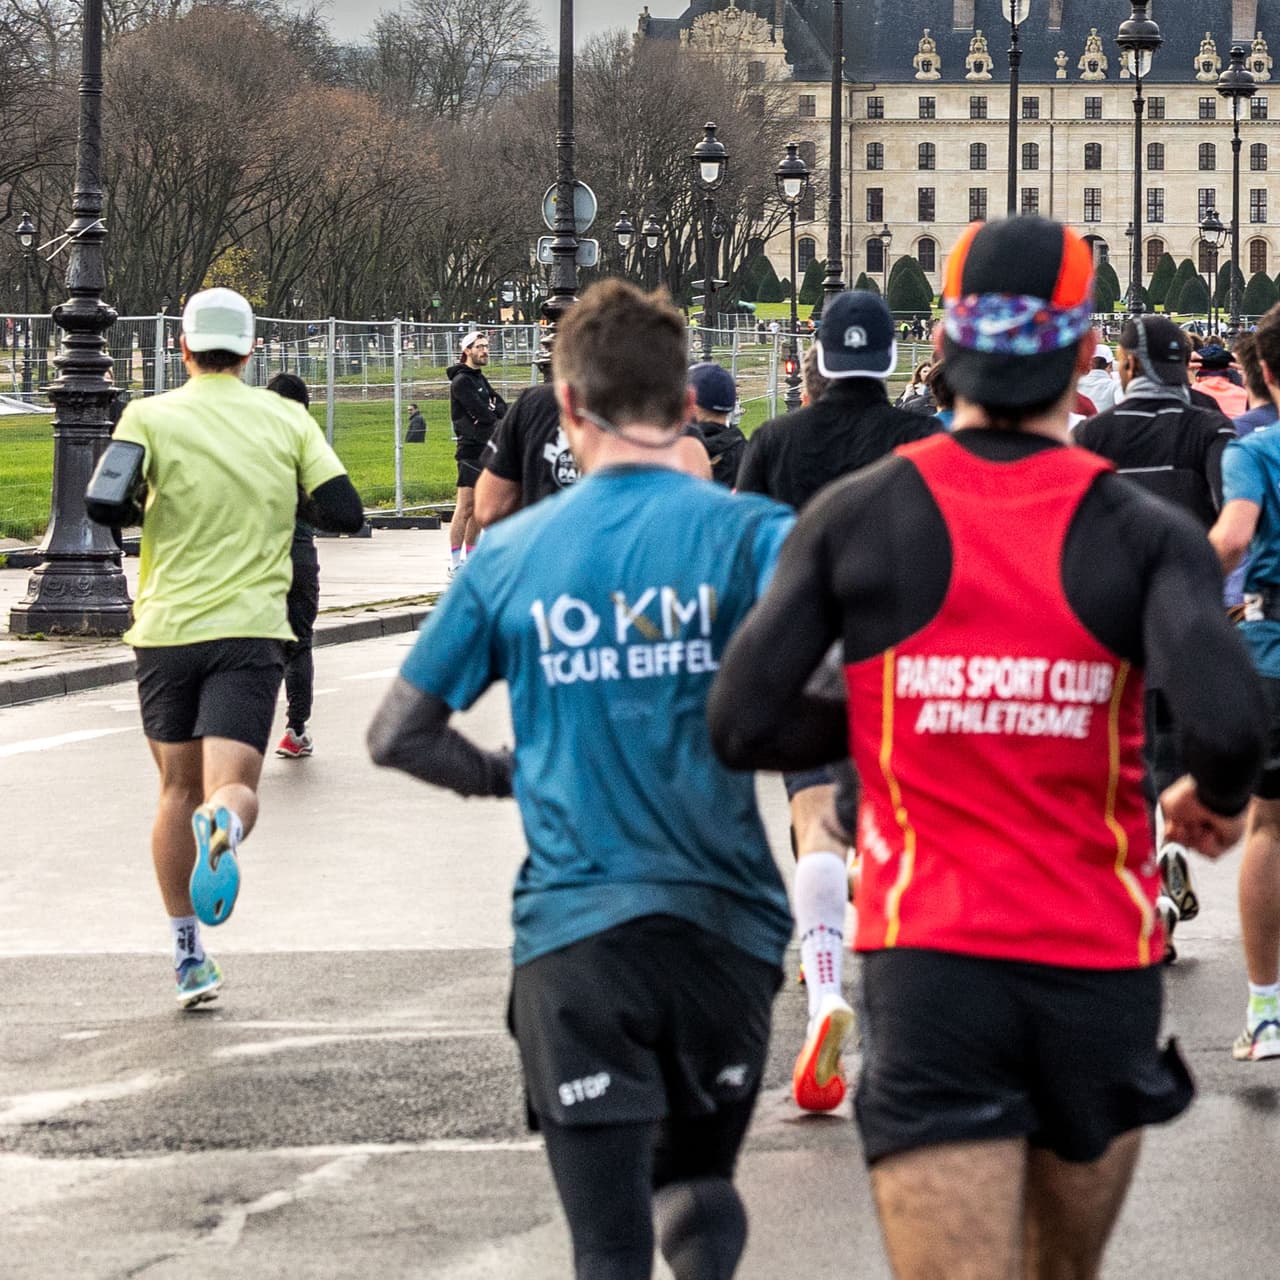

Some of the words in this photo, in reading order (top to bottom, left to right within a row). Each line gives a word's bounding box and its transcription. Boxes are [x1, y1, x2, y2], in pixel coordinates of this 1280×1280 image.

[530, 593, 600, 652] 10
[610, 583, 717, 645] KM
[540, 647, 620, 685] TOUR
[627, 639, 720, 678] EIFFEL
[895, 654, 965, 699] PARIS
[965, 656, 1050, 701] SPORT
[1048, 658, 1114, 705] CLUB
[915, 701, 1092, 738] ATHLETISME
